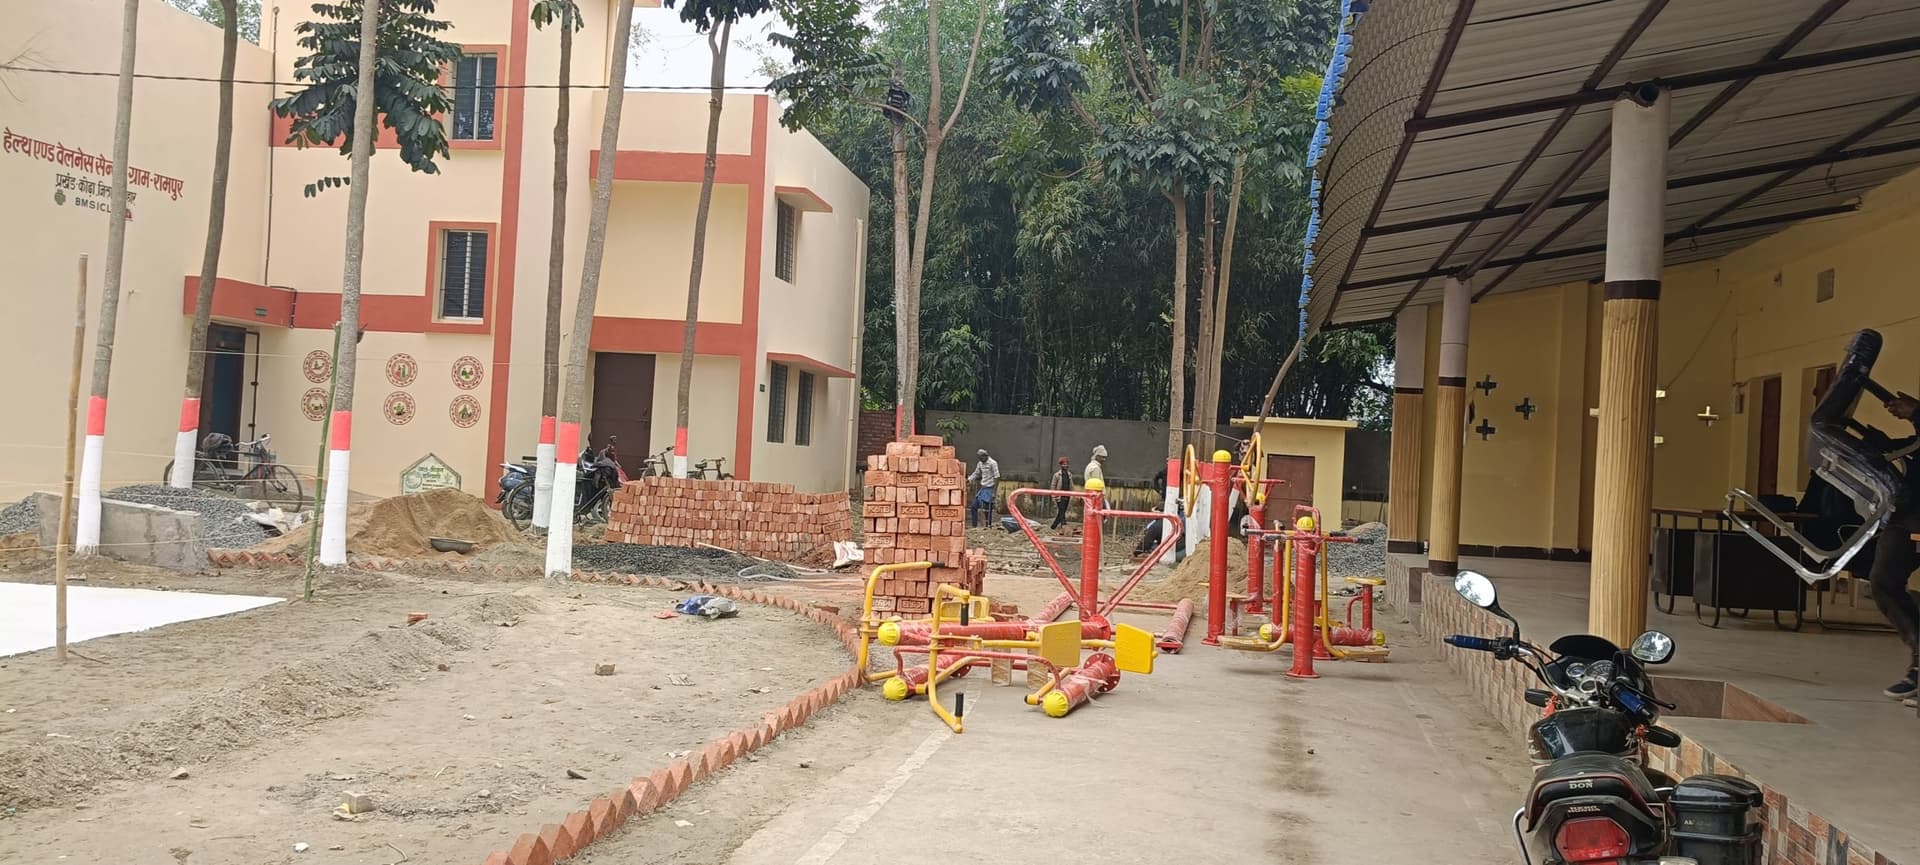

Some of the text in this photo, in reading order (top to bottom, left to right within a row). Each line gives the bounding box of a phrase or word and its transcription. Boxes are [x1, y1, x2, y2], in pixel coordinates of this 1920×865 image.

[3, 127, 32, 157] हेल्थ
[33, 139, 56, 162] एण्ड
[56, 141, 94, 173] वेलनेस
[95, 153, 113, 176] सेन
[75, 197, 112, 213] BMSICL
